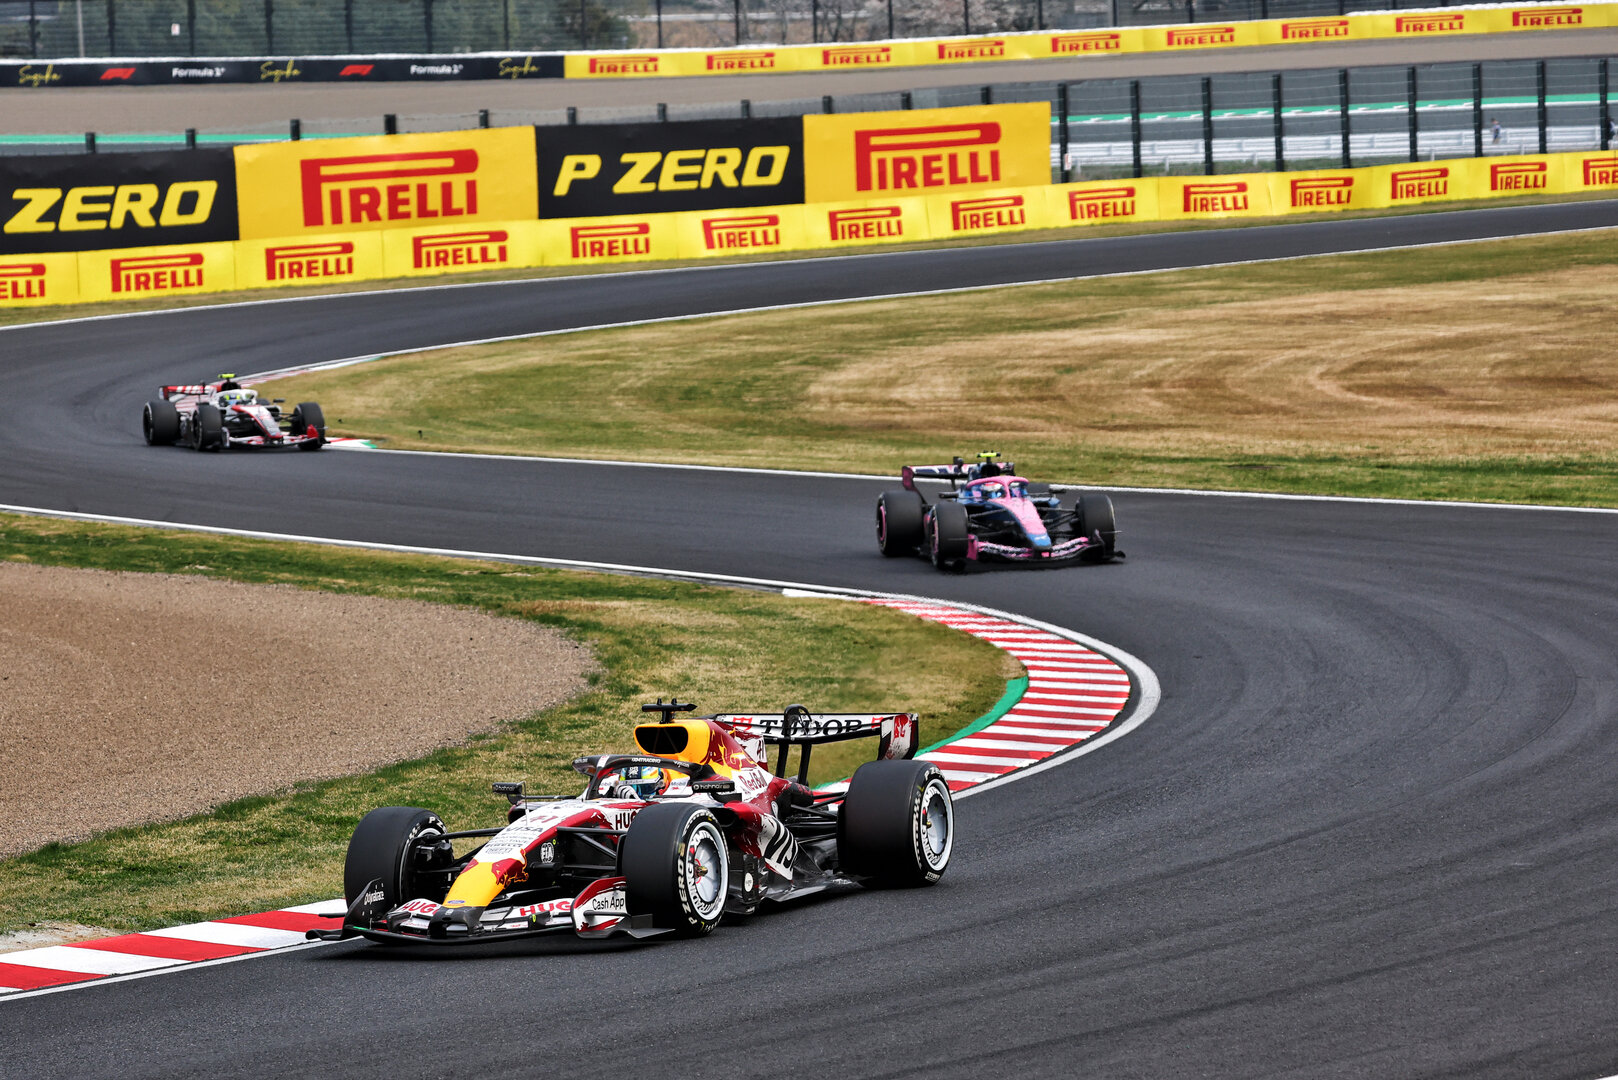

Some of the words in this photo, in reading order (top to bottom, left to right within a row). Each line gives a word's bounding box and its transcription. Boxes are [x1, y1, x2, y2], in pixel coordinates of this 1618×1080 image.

[1282, 21, 1349, 39] PIRELLI
[1396, 15, 1464, 32] PIRELLI
[1512, 8, 1582, 26] PIRELLI
[938, 41, 1004, 59] PIRELLI
[1052, 34, 1120, 52] PIRELLI
[1167, 28, 1234, 45] PIRELLI
[410, 64, 452, 75] Formula
[589, 57, 658, 73] PIRELLI
[707, 53, 774, 70] PIRELLI
[823, 48, 890, 65] PIRELLI
[172, 67, 214, 78] Formula
[553, 154, 602, 196] P
[612, 145, 790, 194] ZERO
[855, 122, 1001, 191] PIRELLI
[300, 149, 479, 227] PIRELLI
[1391, 168, 1449, 199] PIRELLI
[1490, 162, 1547, 190] PIRELLI
[1069, 187, 1135, 219] PIRELLI
[1184, 183, 1248, 212] PIRELLI
[1291, 177, 1354, 207] PIRELLI
[3, 180, 218, 234] ZERO
[951, 196, 1024, 230] PIRELLI
[703, 215, 779, 249] PIRELLI
[829, 207, 902, 240] PIRELLI
[413, 231, 508, 268] PIRELLI
[571, 223, 649, 258] PIRELLI
[111, 253, 203, 292] PIRELLI
[265, 242, 354, 280] PIRELLI
[402, 900, 440, 916] HUG
[519, 900, 572, 917] HUG
[592, 898, 609, 911] Cash
[610, 896, 625, 910] App
